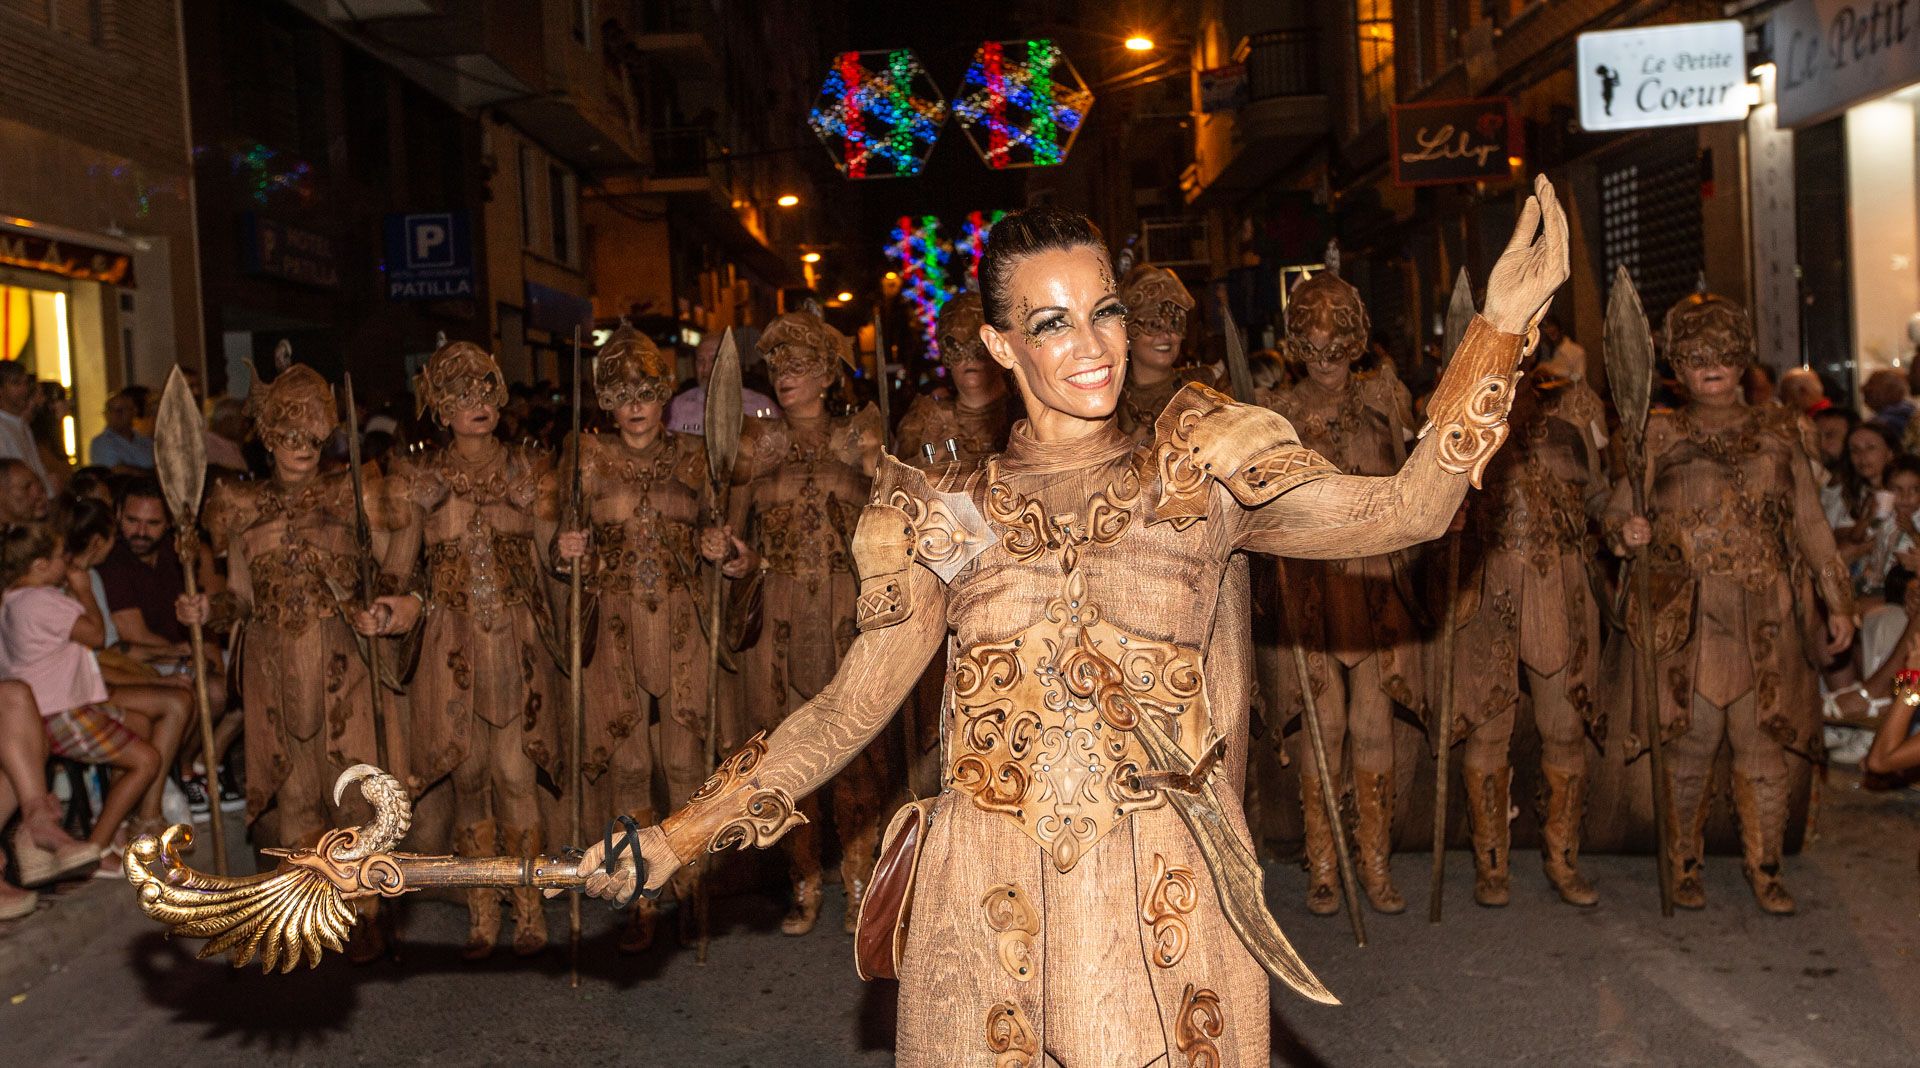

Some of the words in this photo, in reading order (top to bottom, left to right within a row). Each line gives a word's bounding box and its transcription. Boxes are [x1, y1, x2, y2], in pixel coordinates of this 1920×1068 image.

[1641, 54, 1667, 75] Le
[1673, 51, 1734, 72] Petite
[1785, 30, 1818, 91] Le
[1636, 77, 1734, 113] Coeur
[1401, 123, 1500, 168] Lily
[416, 224, 445, 259] P
[390, 279, 471, 298] PATILLA
